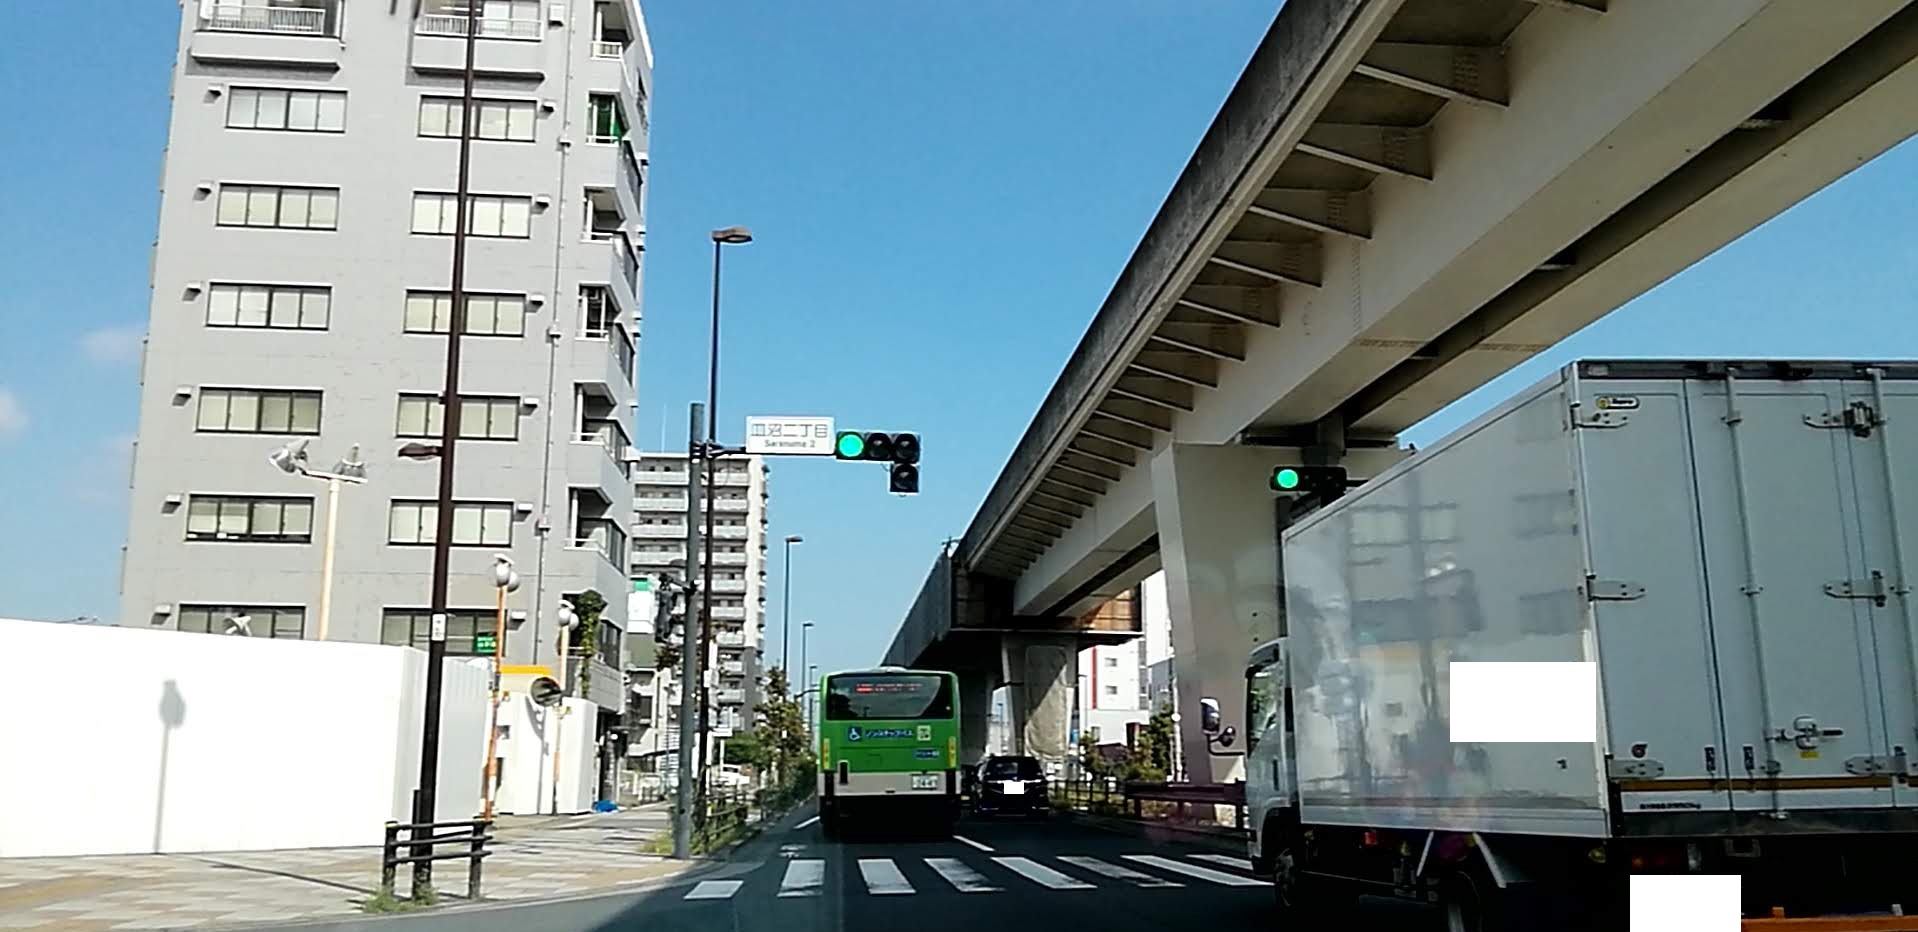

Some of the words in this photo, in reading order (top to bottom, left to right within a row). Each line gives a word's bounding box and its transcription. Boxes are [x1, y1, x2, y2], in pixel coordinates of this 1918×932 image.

[751, 424, 828, 437] 皿沼二丁目
